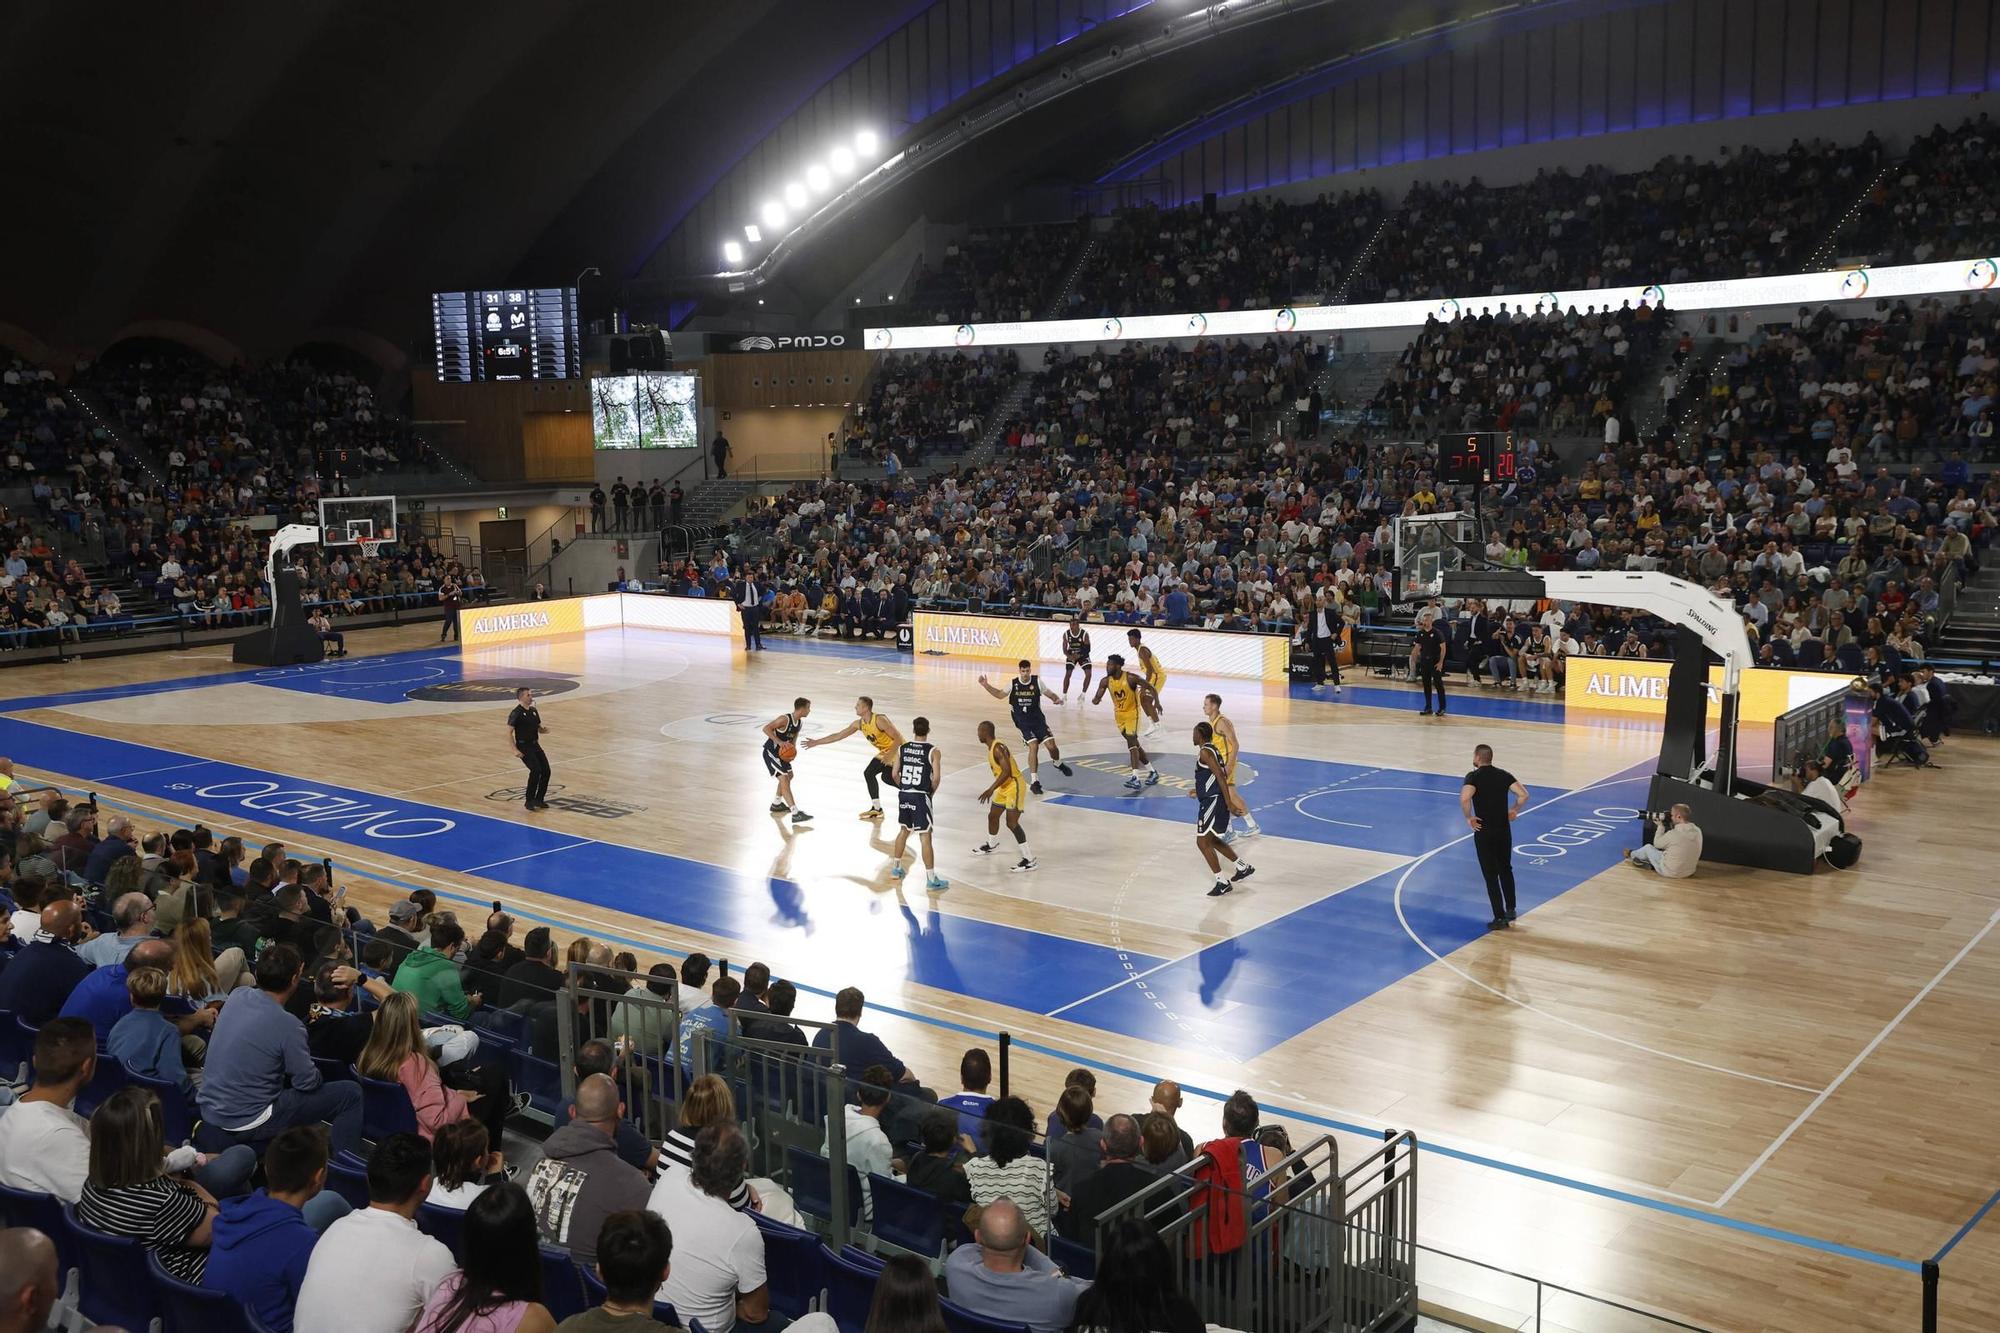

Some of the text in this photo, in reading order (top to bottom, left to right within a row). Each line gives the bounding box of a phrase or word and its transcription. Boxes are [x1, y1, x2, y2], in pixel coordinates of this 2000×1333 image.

[486, 294, 499, 303] 31
[508, 293, 522, 302] 38
[778, 335, 845, 348] PMDO
[1467, 437, 1477, 452] 5
[1506, 436, 1512, 451] 5
[1498, 453, 1514, 476] 20
[473, 611, 550, 634] ALIMERKA
[1686, 608, 1719, 636] SPALDING
[926, 626, 1001, 647] ALIMERKA
[1586, 672, 1720, 704] ALIMEA
[901, 765, 923, 786] 55
